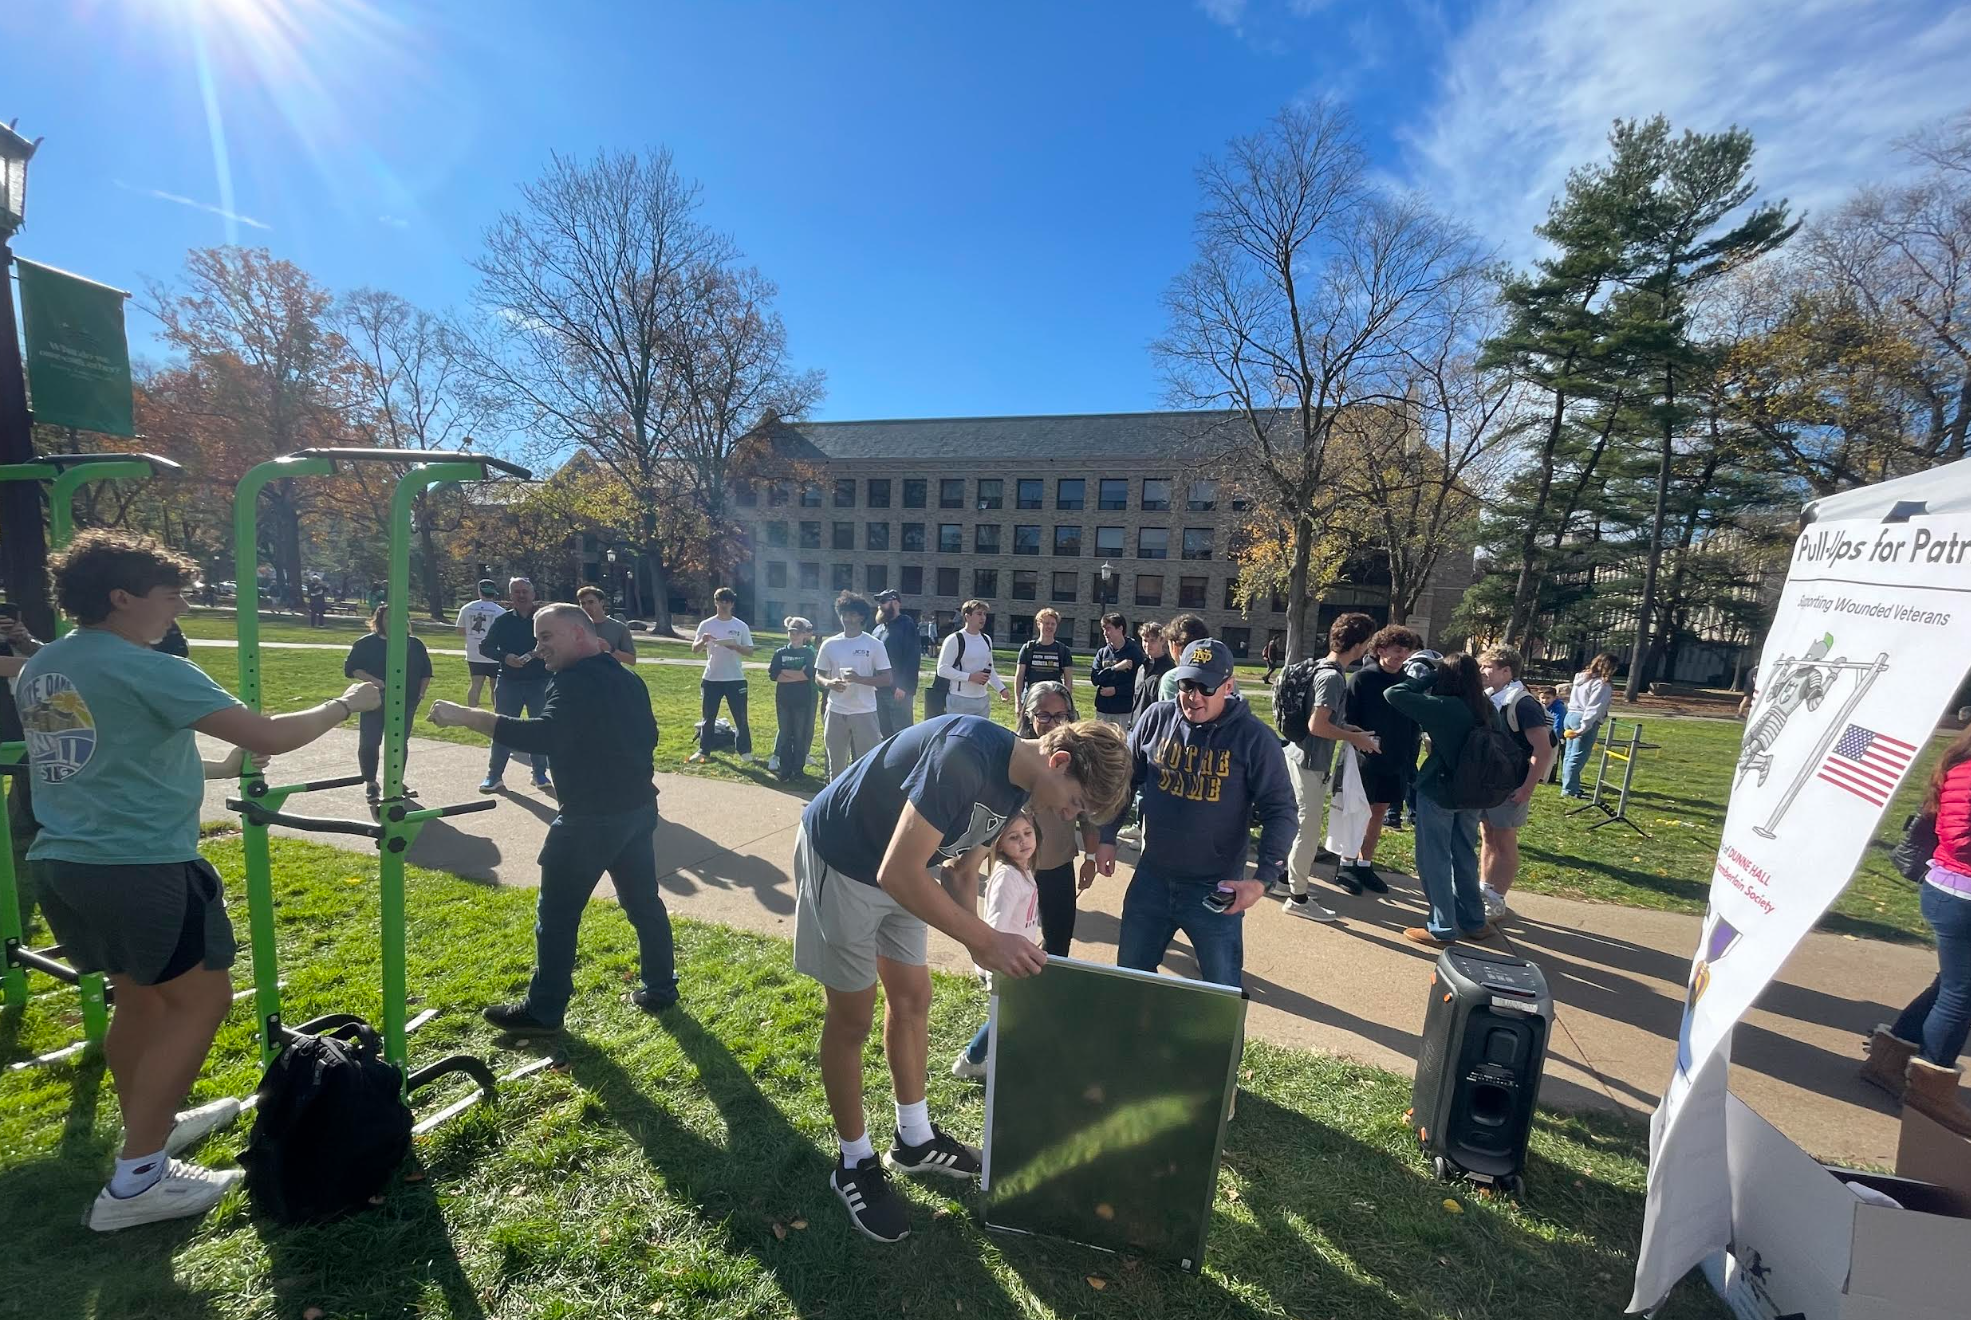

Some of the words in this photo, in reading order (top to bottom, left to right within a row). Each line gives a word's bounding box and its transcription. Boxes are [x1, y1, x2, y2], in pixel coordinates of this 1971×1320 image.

[1868, 528, 1906, 562] for
[1909, 528, 1971, 564] Patr
[1834, 597, 1894, 618] Wounded
[1893, 605, 1951, 626] Veterans
[1154, 737, 1230, 777] NOTRE
[1158, 768, 1222, 801] DAME
[1728, 847, 1752, 872] DUNNE
[1748, 864, 1771, 886] HALL
[1744, 885, 1775, 915] Society
